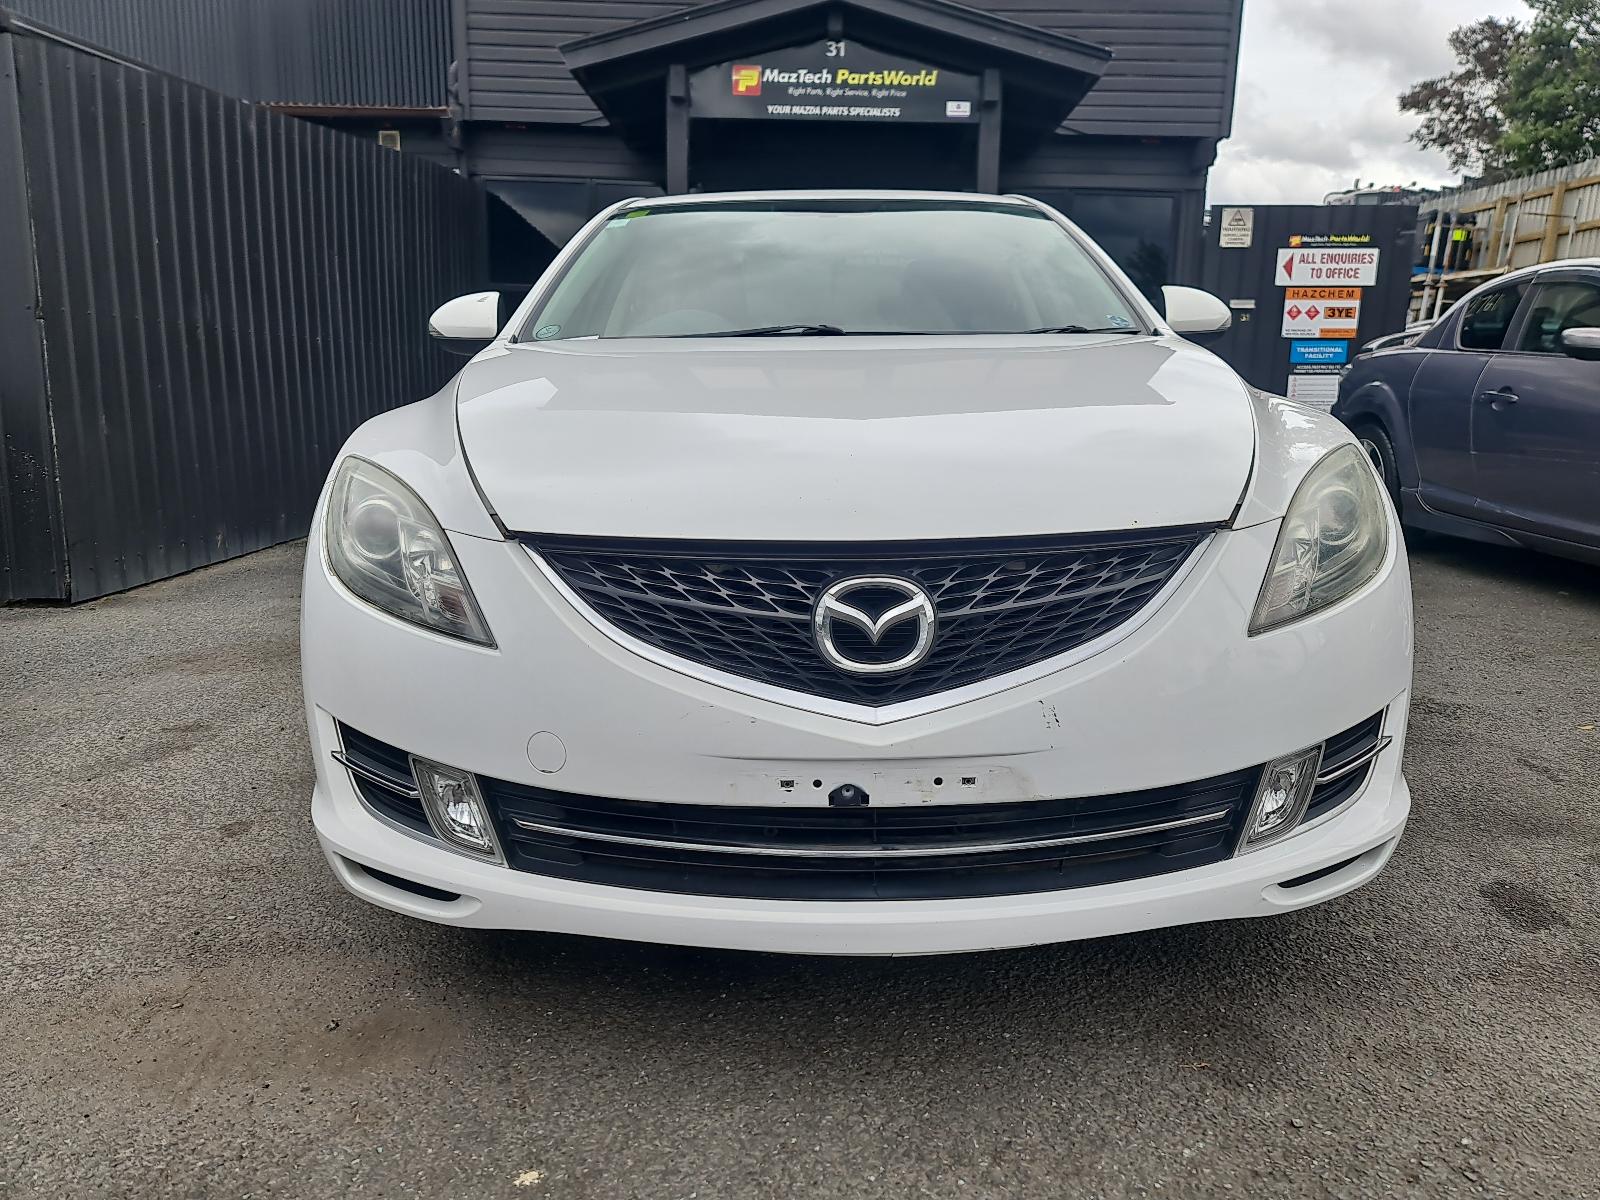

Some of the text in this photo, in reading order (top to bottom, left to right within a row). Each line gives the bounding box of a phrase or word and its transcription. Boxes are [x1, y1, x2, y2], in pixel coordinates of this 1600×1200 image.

[825, 41, 846, 57] 31
[763, 68, 938, 86] MazTech PartsWorld
[767, 105, 901, 117] YOUR MAZDA PARTS SPECIALISTS
[1298, 253, 1375, 265] ALL ENQUIRIES
[1310, 267, 1360, 279] TO OFFICE
[1292, 289, 1355, 299] HAZCHEM
[1327, 308, 1353, 318] 3YE
